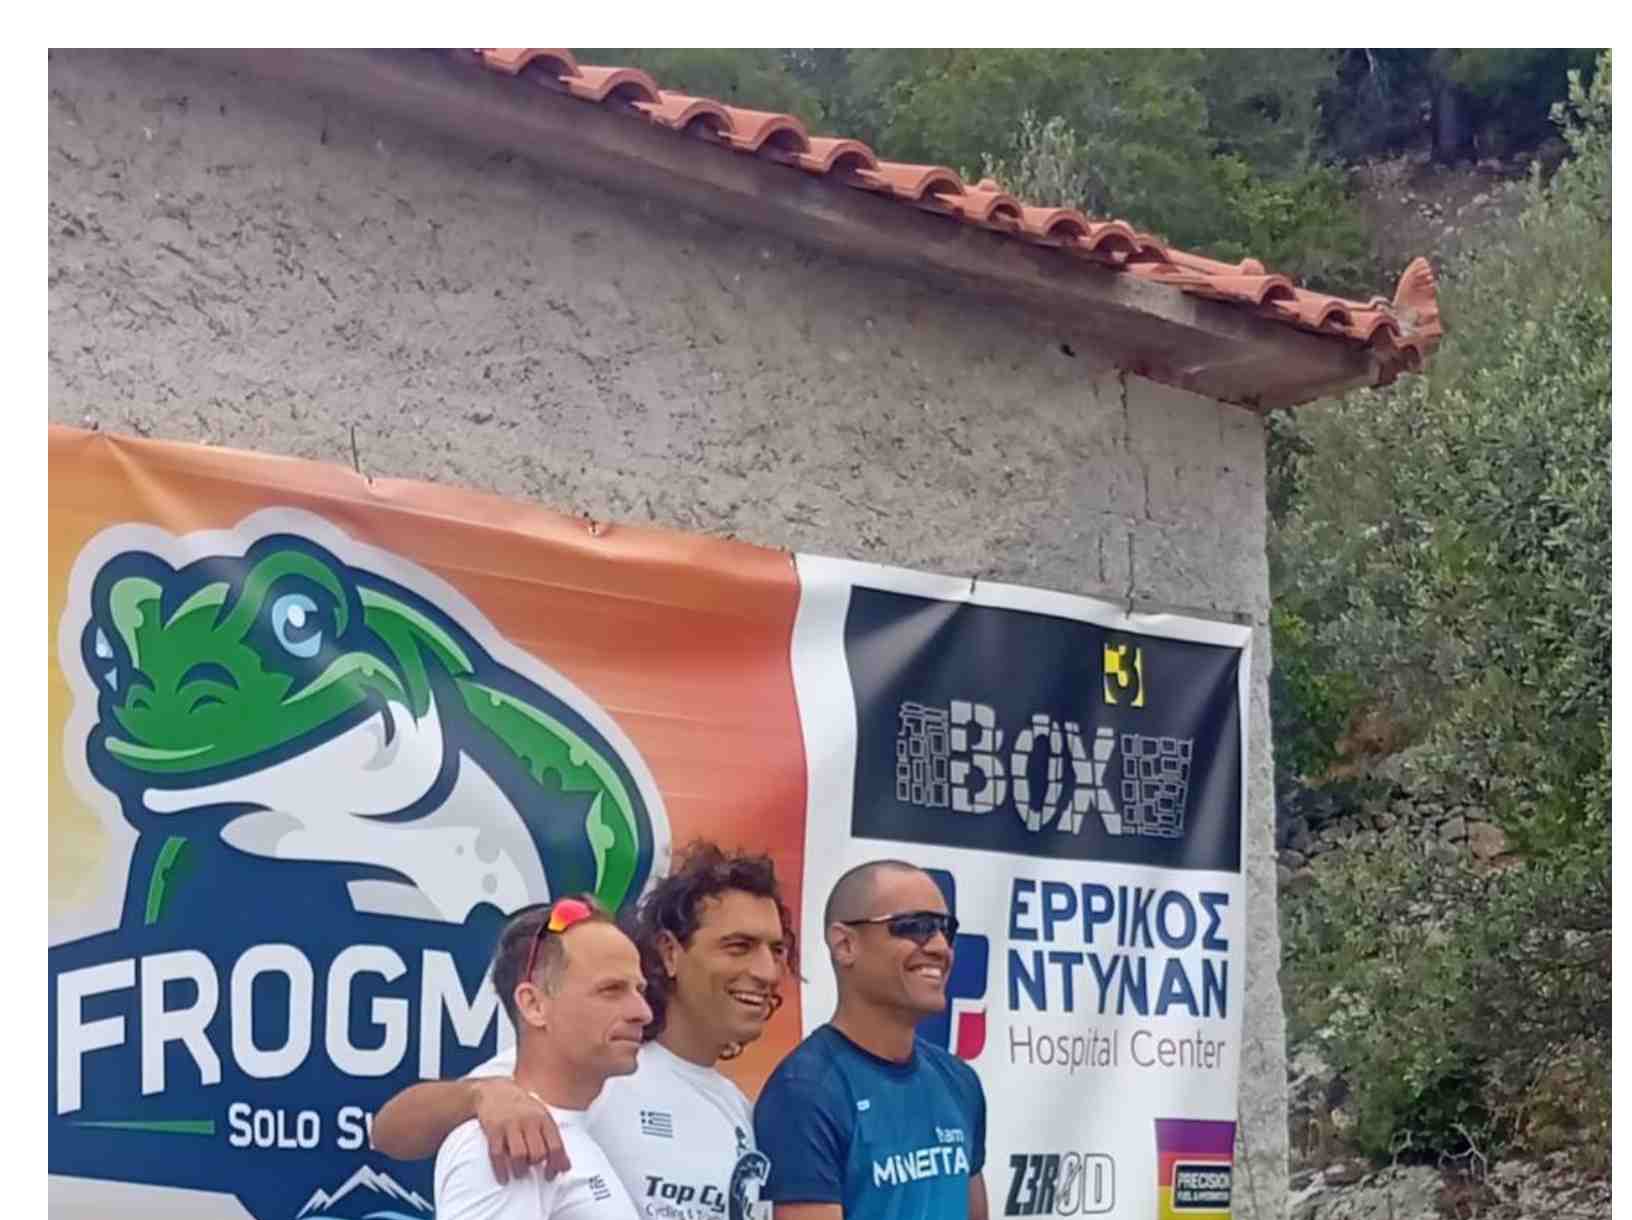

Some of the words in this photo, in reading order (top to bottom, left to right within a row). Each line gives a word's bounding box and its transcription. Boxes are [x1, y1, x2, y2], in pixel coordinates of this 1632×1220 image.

[1009, 878, 1230, 952] ΕΡΡΙΚΟΣ
[1008, 949, 1228, 1019] ΝΤΥΝΑΝ
[1008, 1025, 1119, 1074] Hospital
[1129, 1029, 1227, 1069] Center
[645, 1175, 696, 1205] Top
